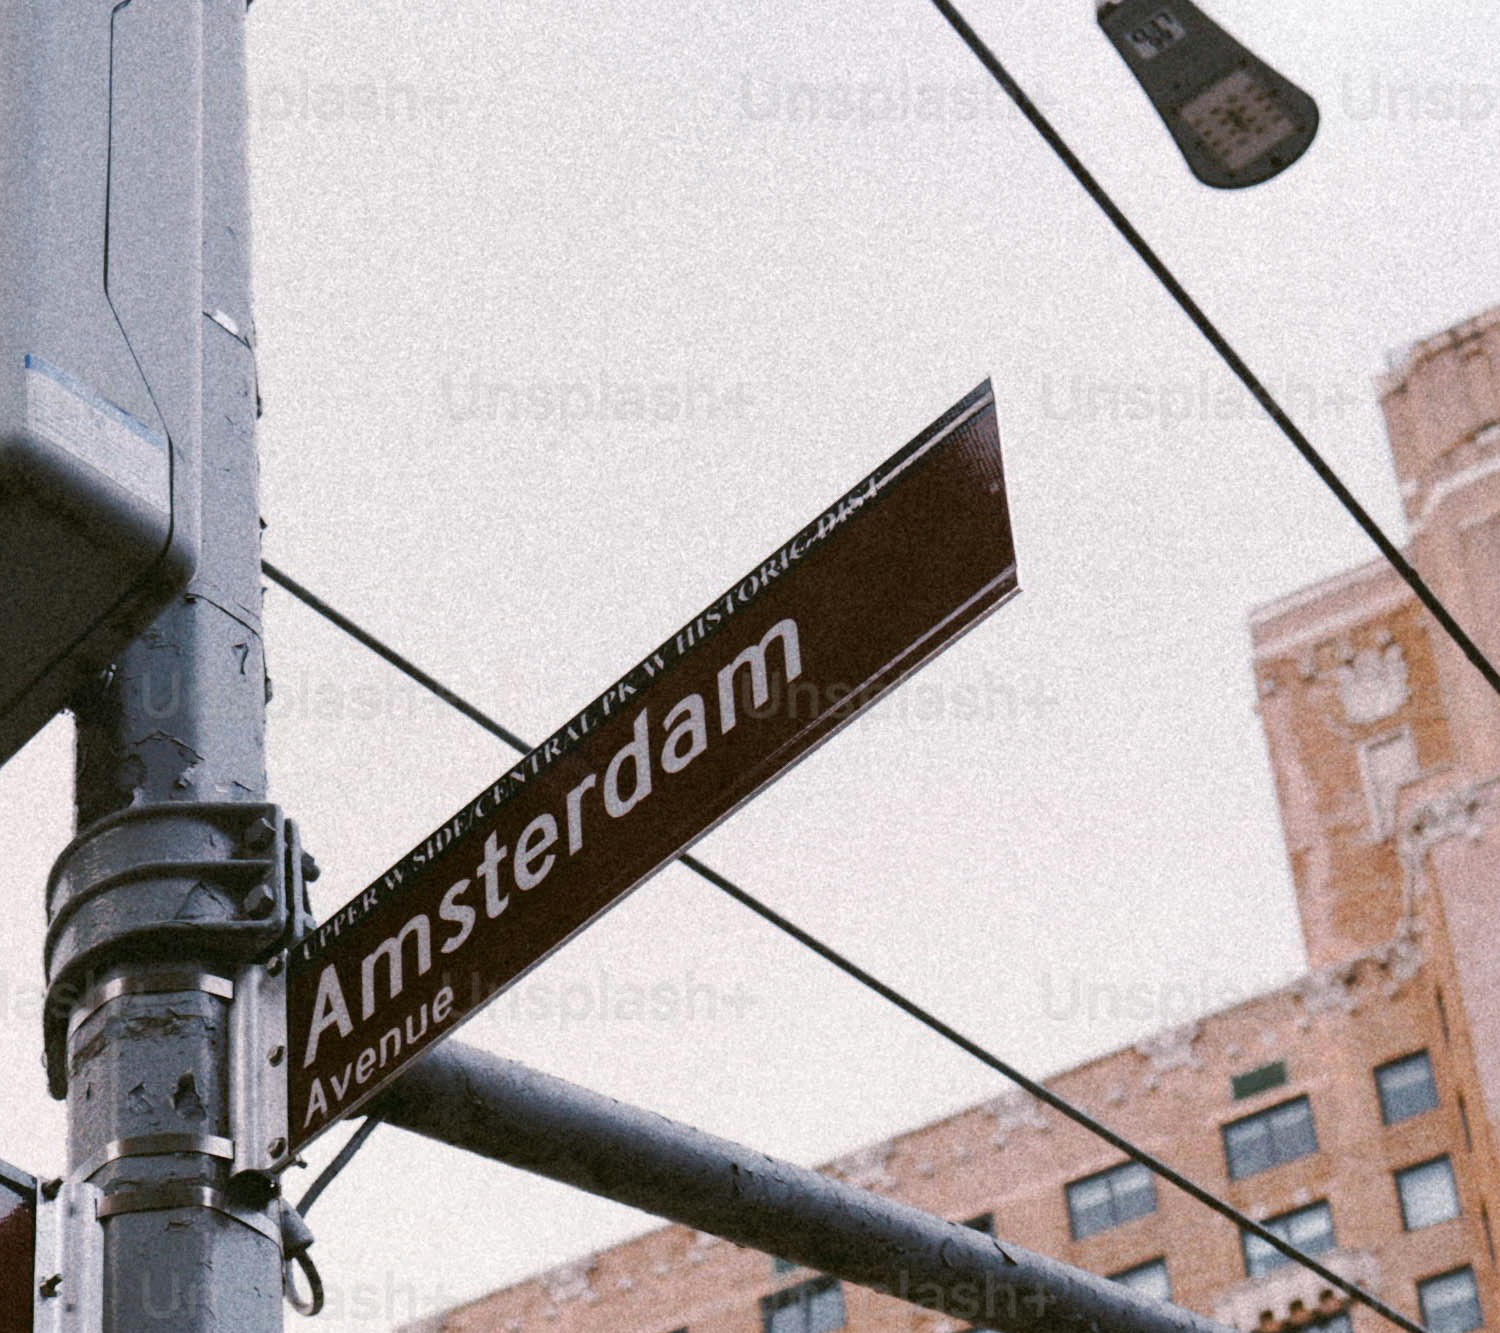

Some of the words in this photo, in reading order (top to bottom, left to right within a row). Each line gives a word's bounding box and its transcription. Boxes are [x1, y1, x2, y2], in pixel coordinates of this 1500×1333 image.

[302, 617, 803, 1070] Amsterdam
[303, 888, 378, 960] UPPER
[384, 867, 404, 890] W
[412, 712, 598, 872] SIDE/CENTRAL
[601, 681, 638, 716] PK
[643, 654, 665, 678] W
[676, 537, 806, 656] HISTORIC
[302, 985, 455, 1129] Avenue
